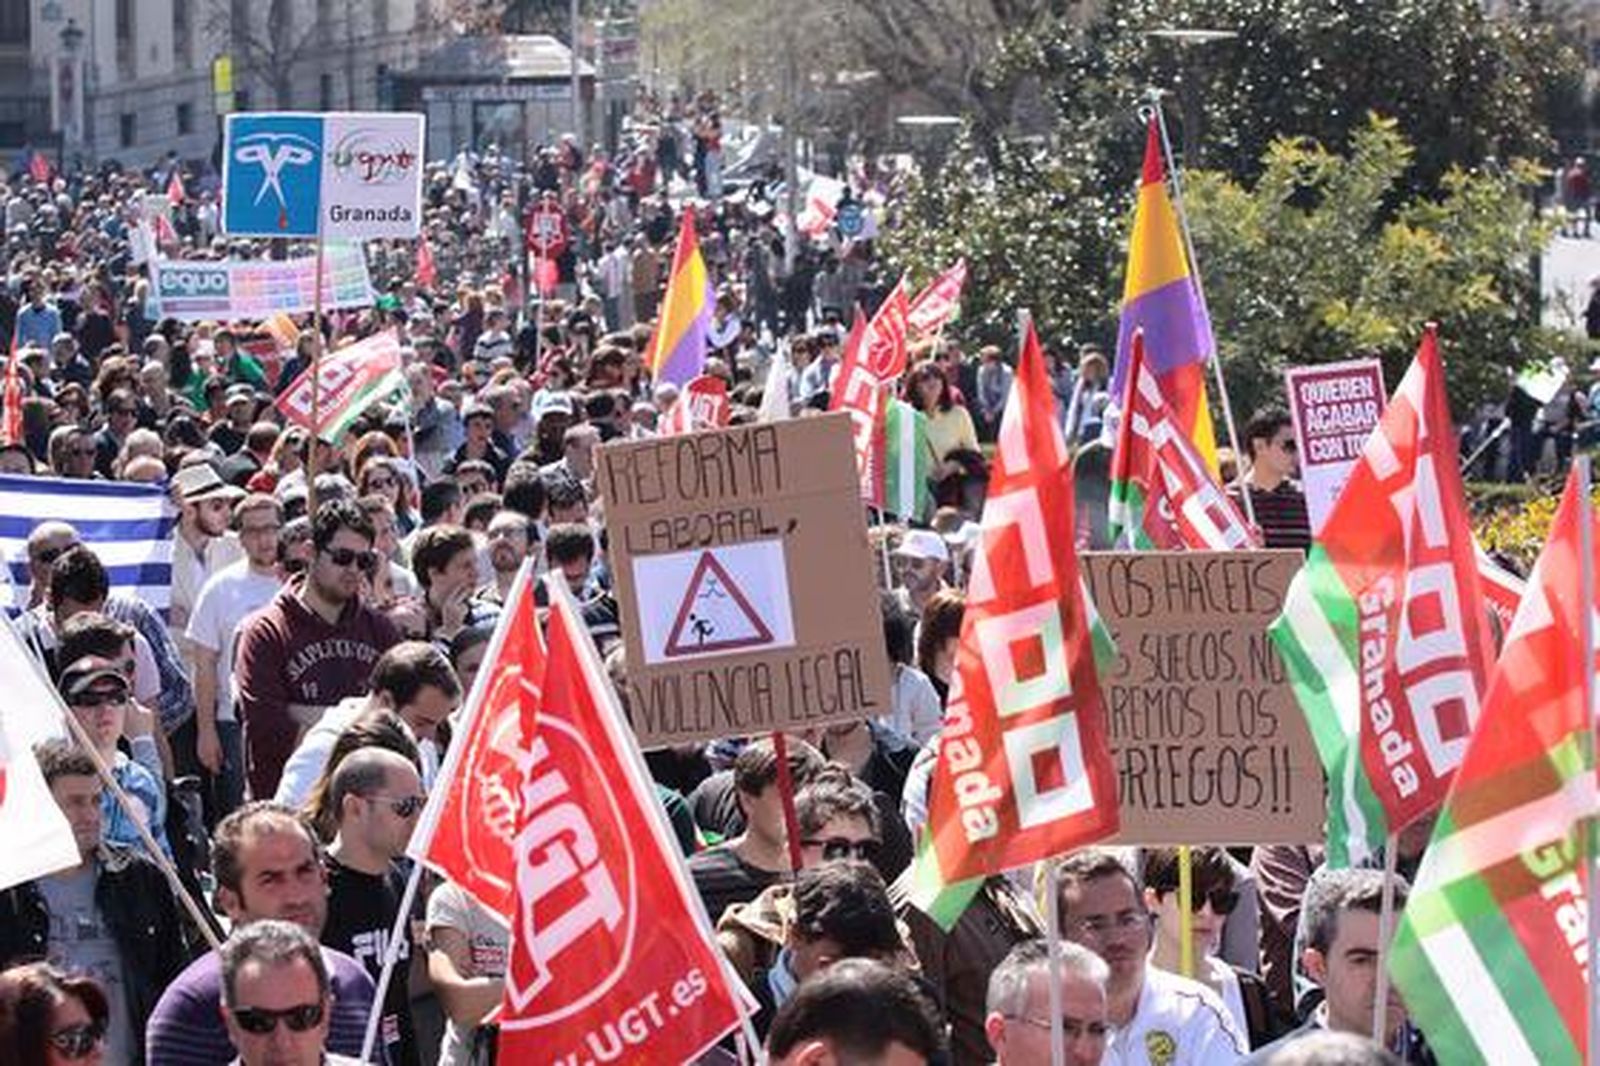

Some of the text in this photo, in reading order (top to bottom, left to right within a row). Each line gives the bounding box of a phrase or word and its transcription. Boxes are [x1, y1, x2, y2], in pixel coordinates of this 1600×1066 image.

[330, 205, 412, 223] Granada
[161, 271, 227, 295] equo
[1300, 375, 1374, 407] QUIEREN
[1306, 399, 1378, 433] ACABAR
[606, 425, 781, 504] REFORMA
[1309, 436, 1345, 462] CON
[624, 508, 798, 553] LABORAL,
[1163, 556, 1283, 615] HACEIS
[633, 648, 877, 734] VIOLENCIA LEGAL
[1216, 687, 1278, 740] LOS
[1360, 577, 1421, 798] Granada
[942, 664, 1003, 844] nada
[489, 698, 625, 972] UGT
